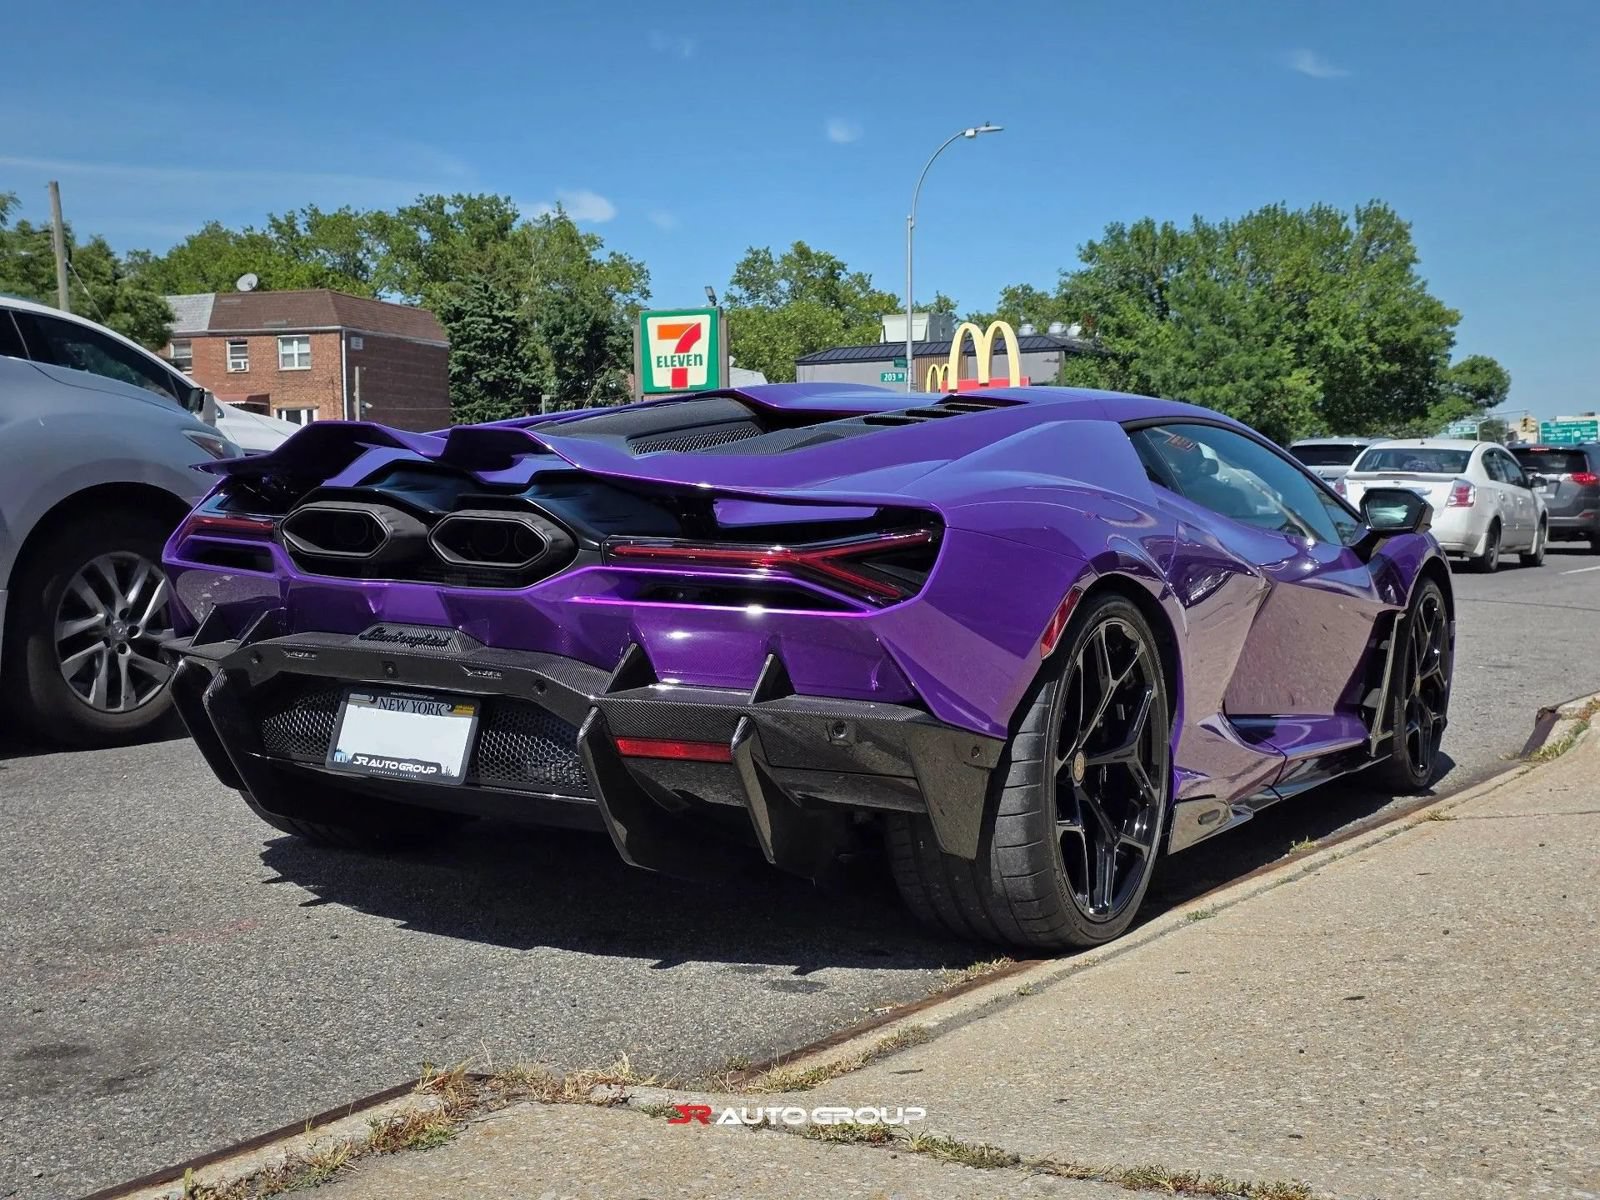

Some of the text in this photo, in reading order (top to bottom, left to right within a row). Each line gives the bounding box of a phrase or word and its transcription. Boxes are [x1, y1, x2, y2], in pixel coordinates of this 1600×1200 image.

[657, 322, 702, 389] 7
[883, 373, 896, 382] 203
[378, 698, 408, 712] NEW
[411, 702, 445, 716] YORK
[368, 758, 399, 770] AUTO
[399, 762, 437, 774] GROUP
